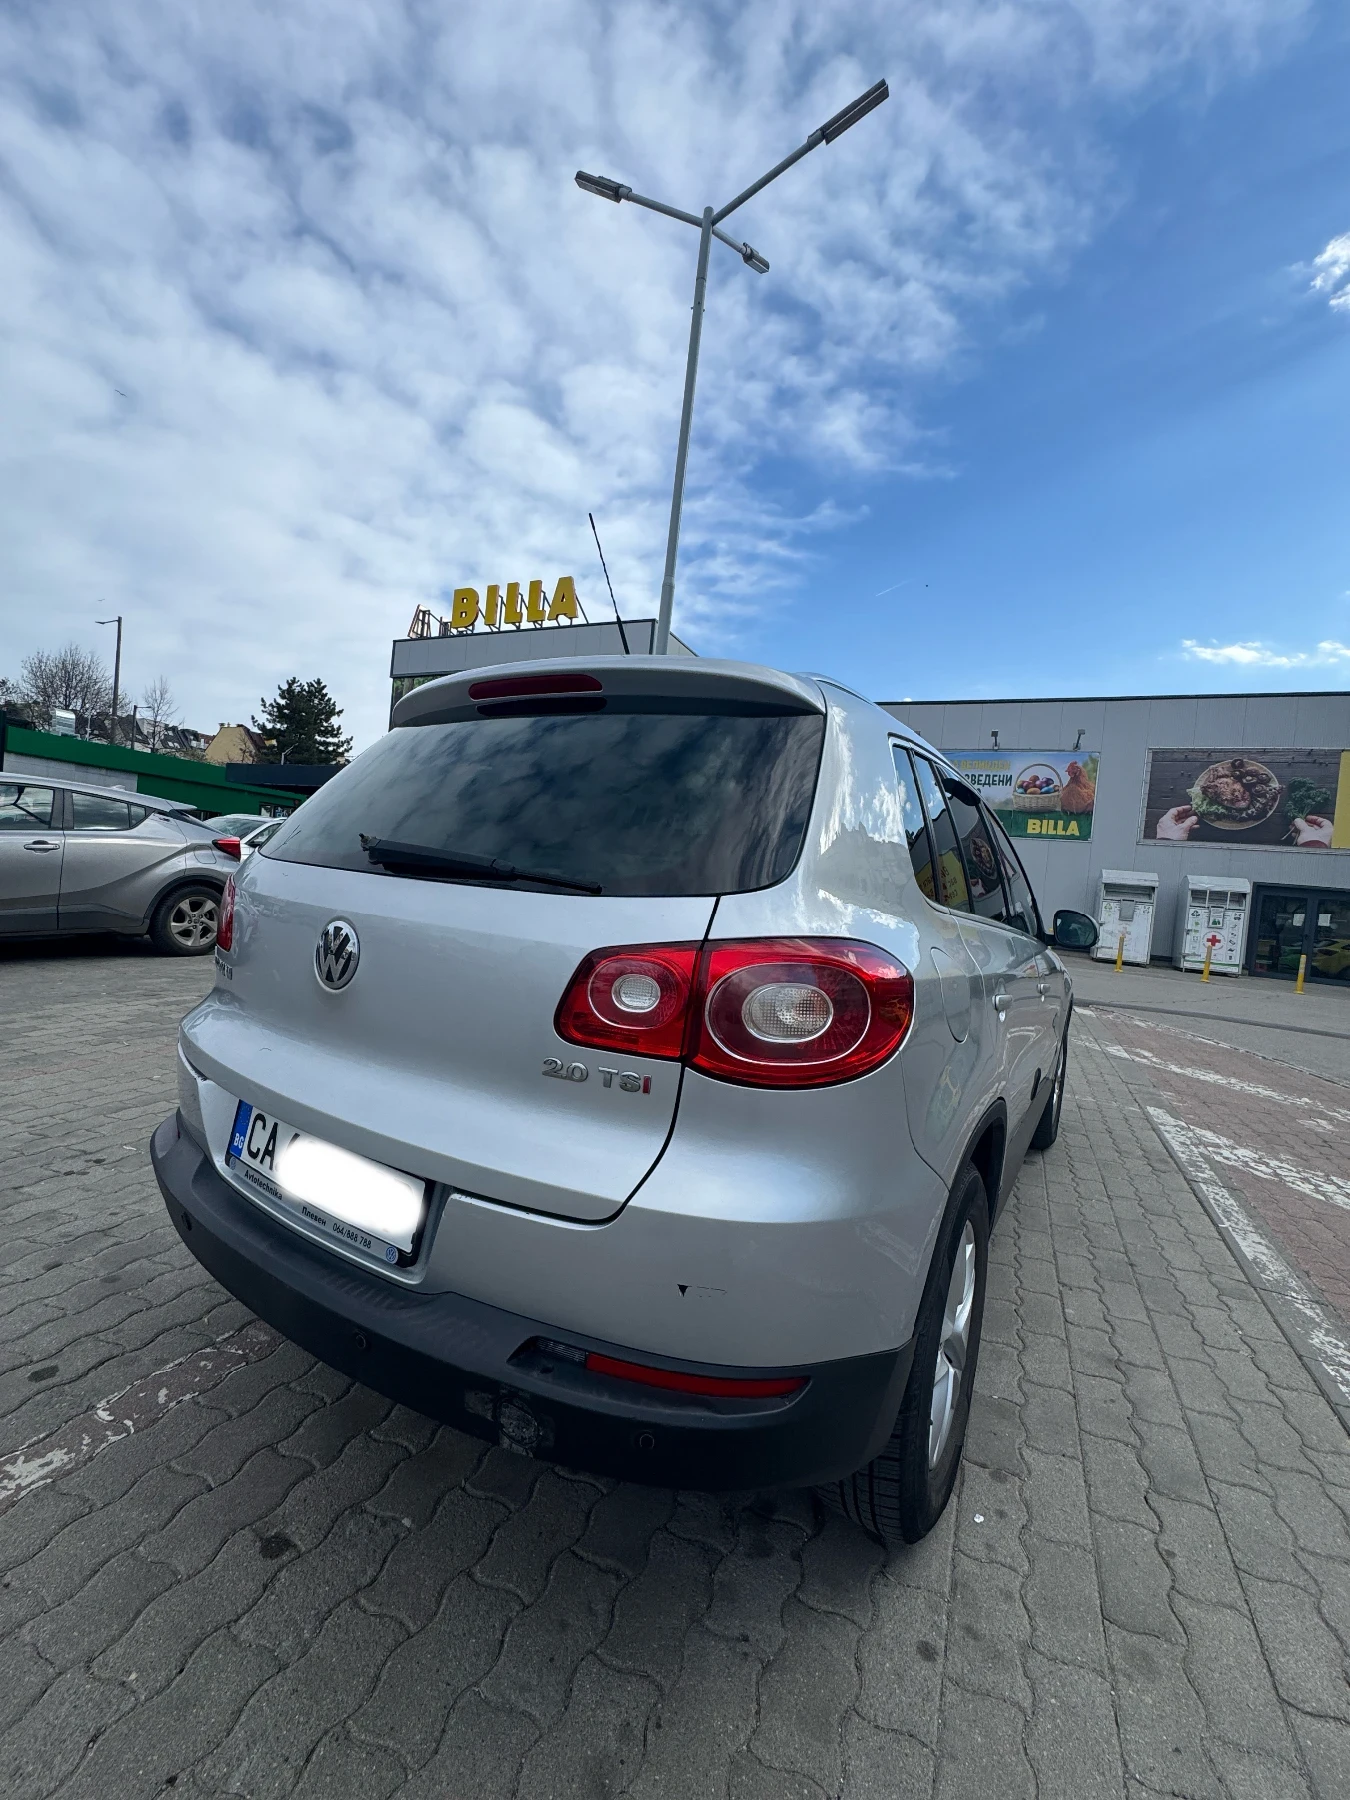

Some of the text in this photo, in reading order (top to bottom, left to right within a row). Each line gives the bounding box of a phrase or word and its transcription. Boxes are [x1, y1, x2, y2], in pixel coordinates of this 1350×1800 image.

[451, 576, 579, 629] BILLA
[1026, 818, 1080, 836] BILLA
[598, 1066, 652, 1095] TSI
[233, 1132, 245, 1149] BG
[244, 1169, 283, 1200] Avtotechnika
[302, 1206, 326, 1226] Плевен
